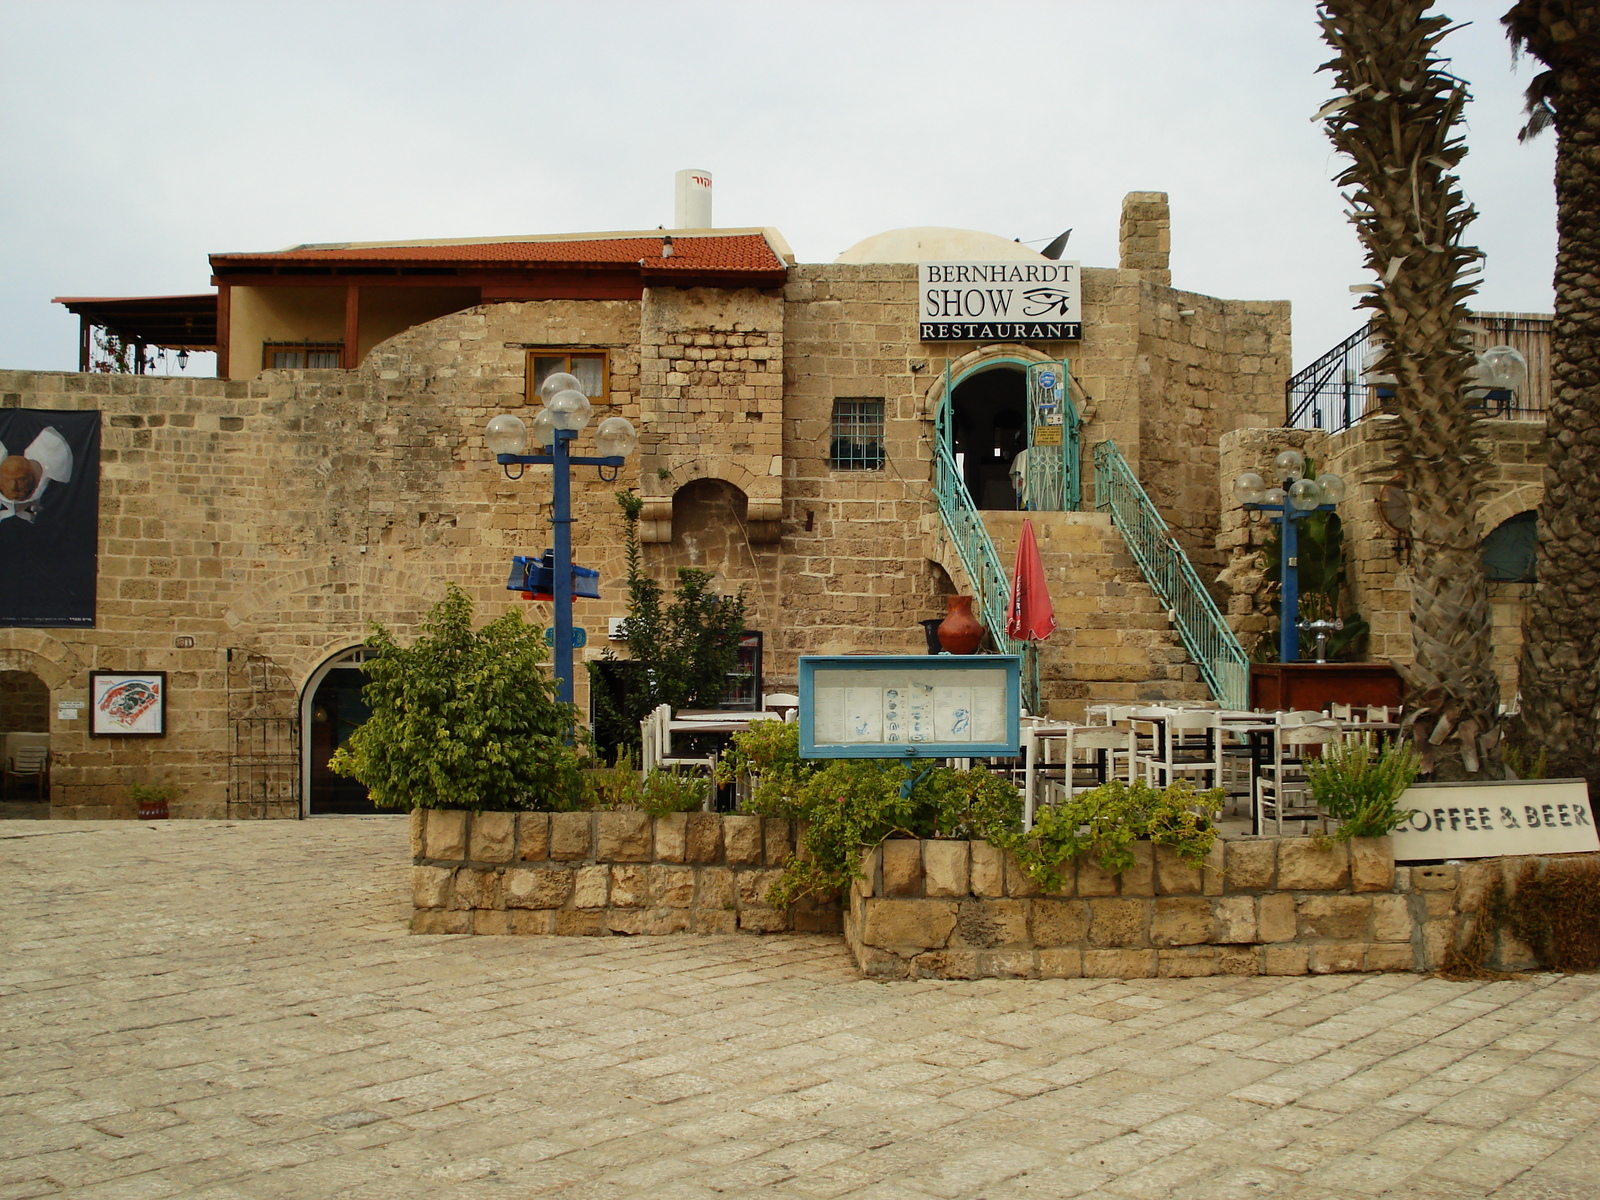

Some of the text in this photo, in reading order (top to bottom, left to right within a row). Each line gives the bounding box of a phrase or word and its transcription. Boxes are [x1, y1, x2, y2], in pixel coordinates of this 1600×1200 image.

[927, 265, 1074, 283] BERNHARDT
[926, 289, 1013, 317] SHOW
[921, 324, 1079, 338] RESTAURANT
[1500, 806, 1521, 829] &
[1524, 803, 1590, 828] BEER
